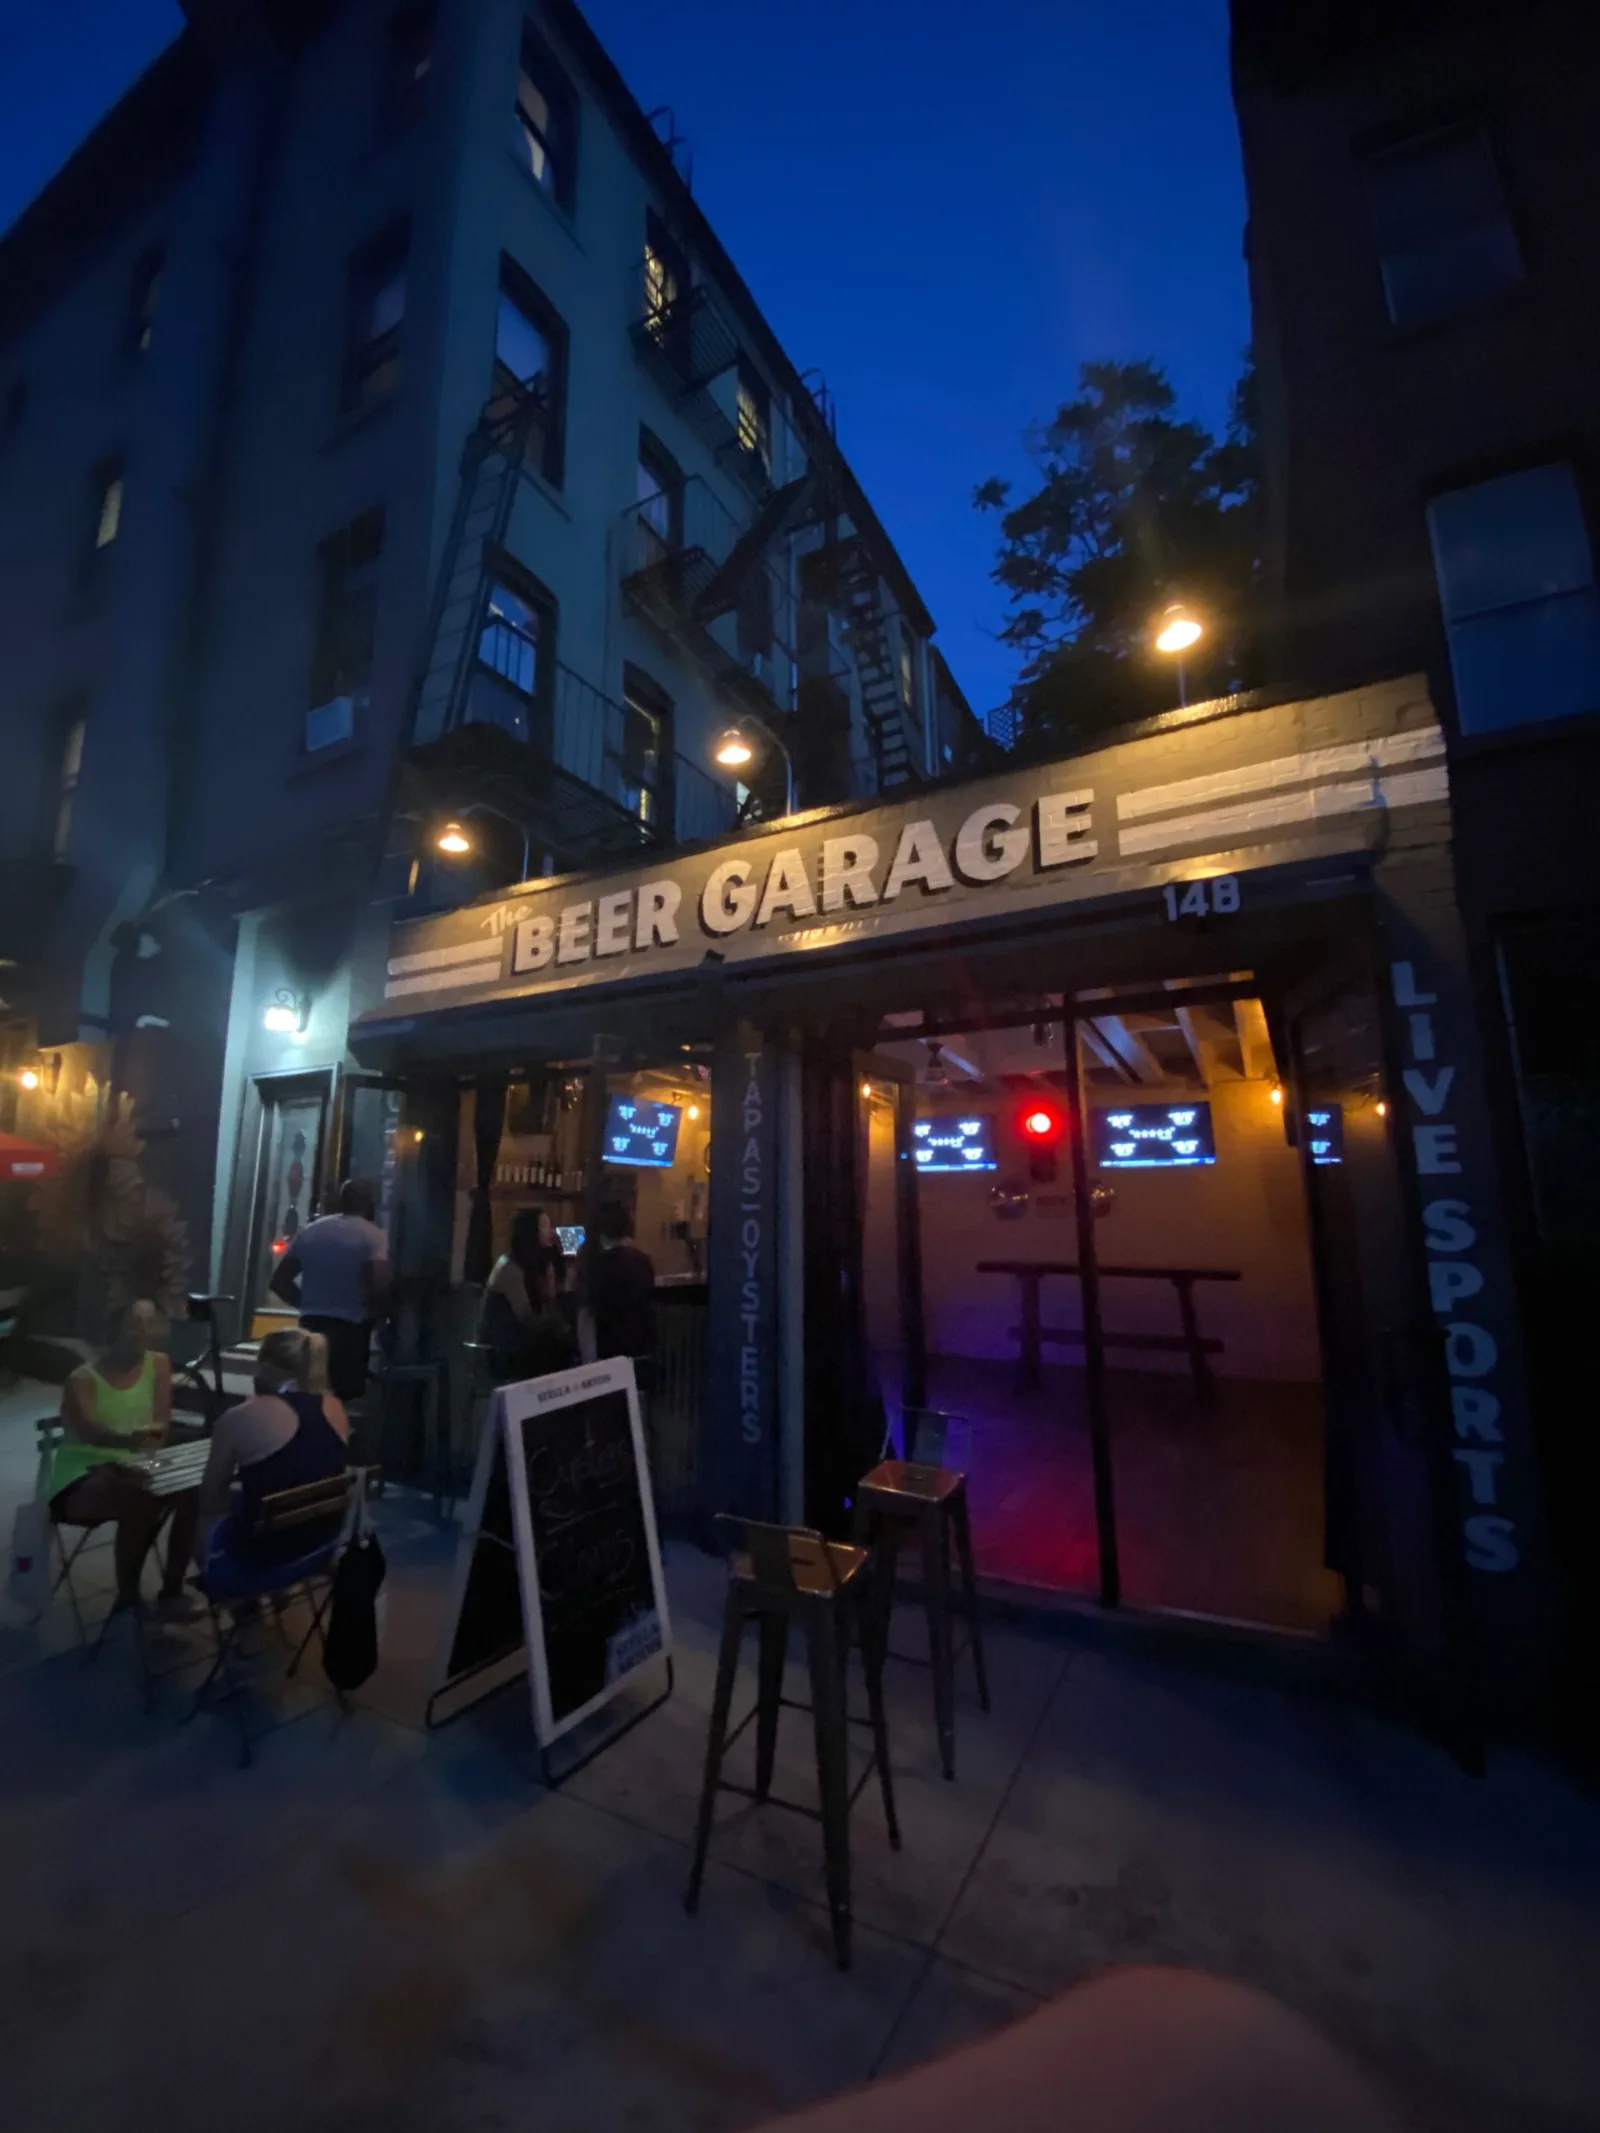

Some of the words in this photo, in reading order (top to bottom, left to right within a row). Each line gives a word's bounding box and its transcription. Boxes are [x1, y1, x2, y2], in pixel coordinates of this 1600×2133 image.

[481, 905, 532, 936] The
[511, 880, 682, 975] BEER
[699, 788, 1098, 937] GARAGE
[1162, 875, 1241, 921] 148
[1389, 961, 1463, 1175] LIVE
[1421, 1198, 1521, 1573] SPORTS
